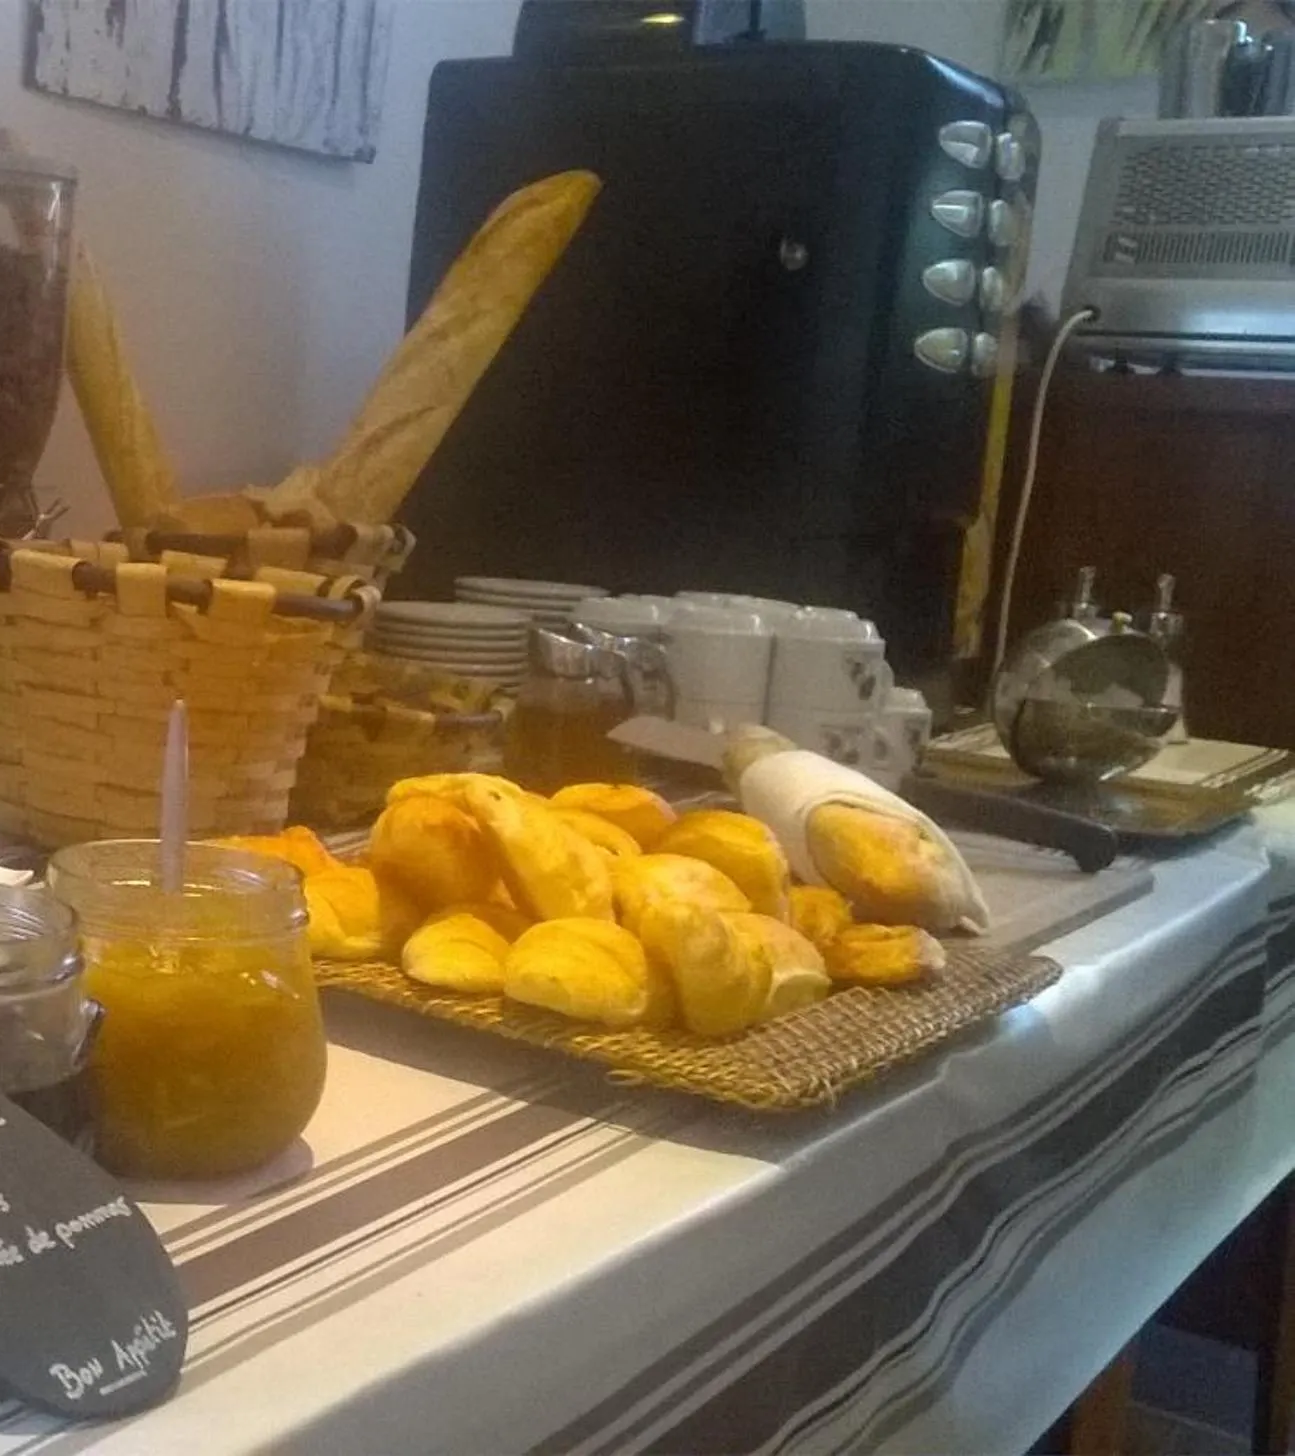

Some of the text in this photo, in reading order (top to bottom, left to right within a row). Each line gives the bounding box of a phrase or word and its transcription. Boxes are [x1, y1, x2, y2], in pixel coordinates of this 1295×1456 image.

[24, 1224, 57, 1254] de
[55, 1195, 133, 1250] pommes
[48, 1357, 104, 1400] Bon
